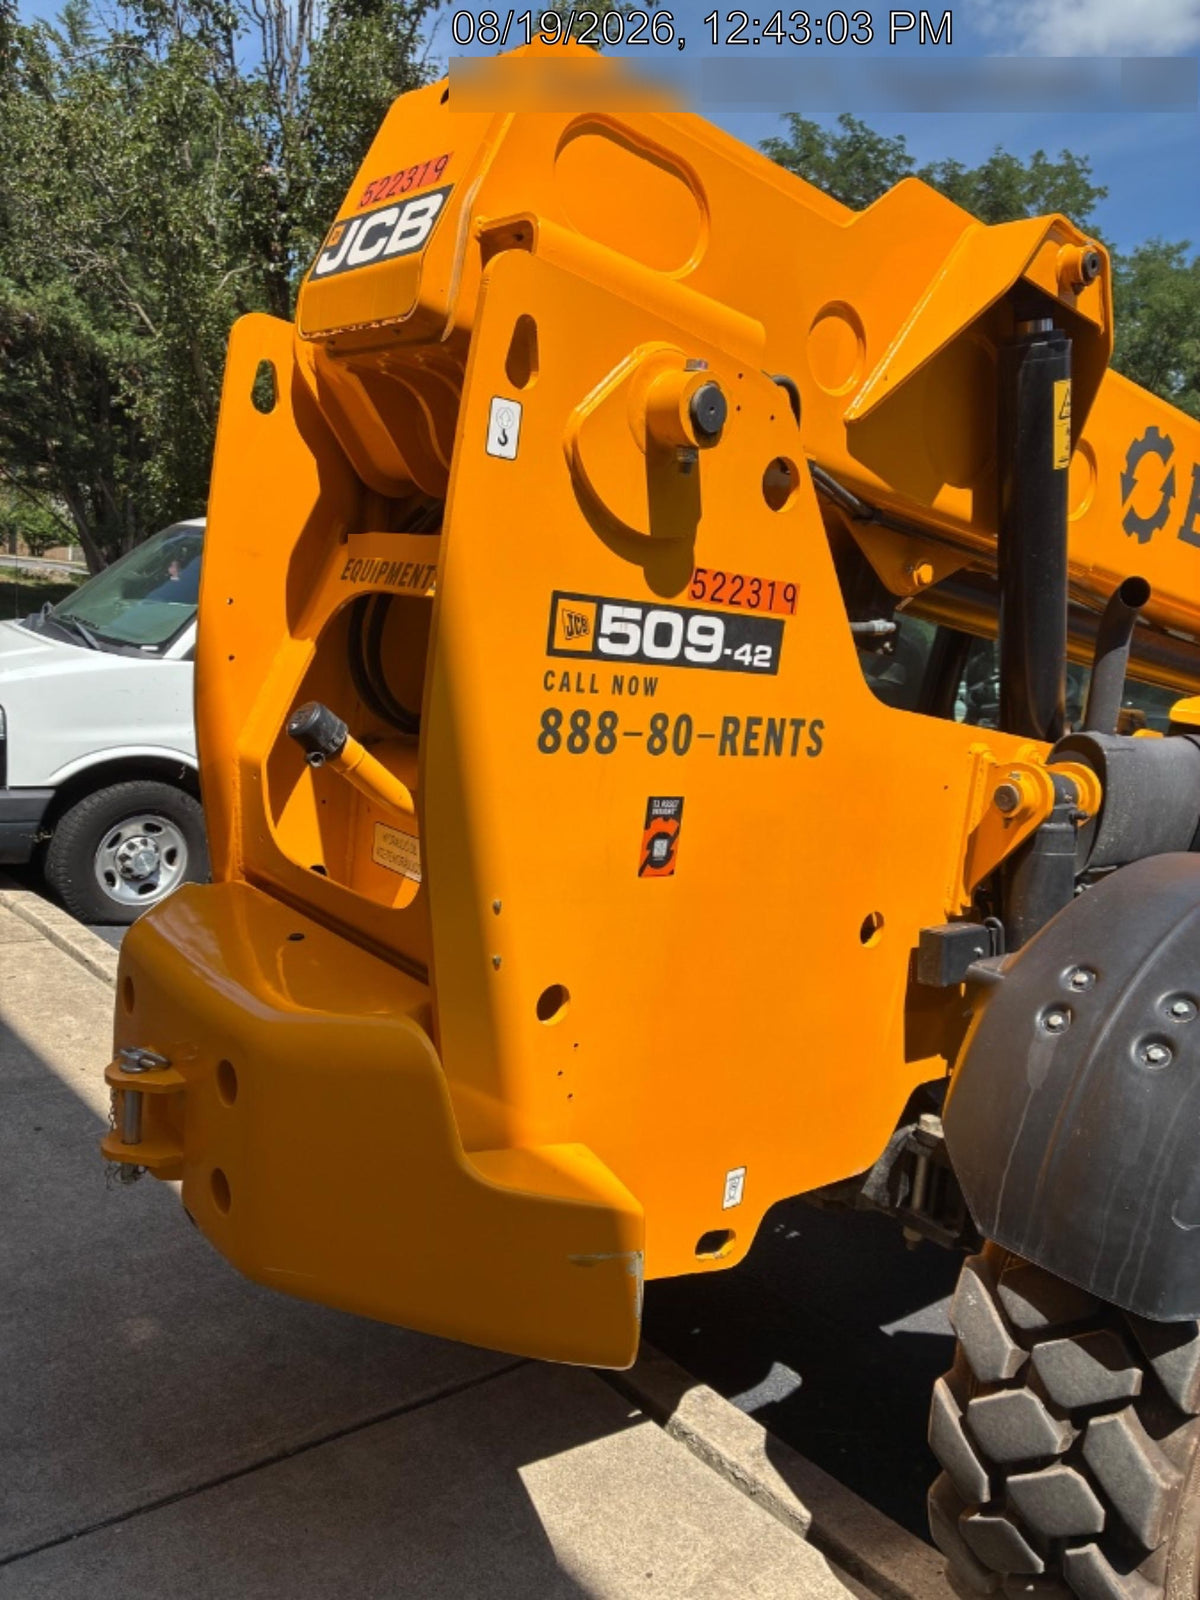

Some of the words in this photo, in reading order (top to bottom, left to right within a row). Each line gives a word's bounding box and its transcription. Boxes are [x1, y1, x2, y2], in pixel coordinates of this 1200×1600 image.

[360, 154, 449, 207] 522319
[316, 193, 443, 275] JCB
[691, 568, 798, 614] 522319
[543, 670, 600, 694] CALL
[611, 675, 659, 697] NOW
[537, 707, 826, 758] 888-80-RENTS
